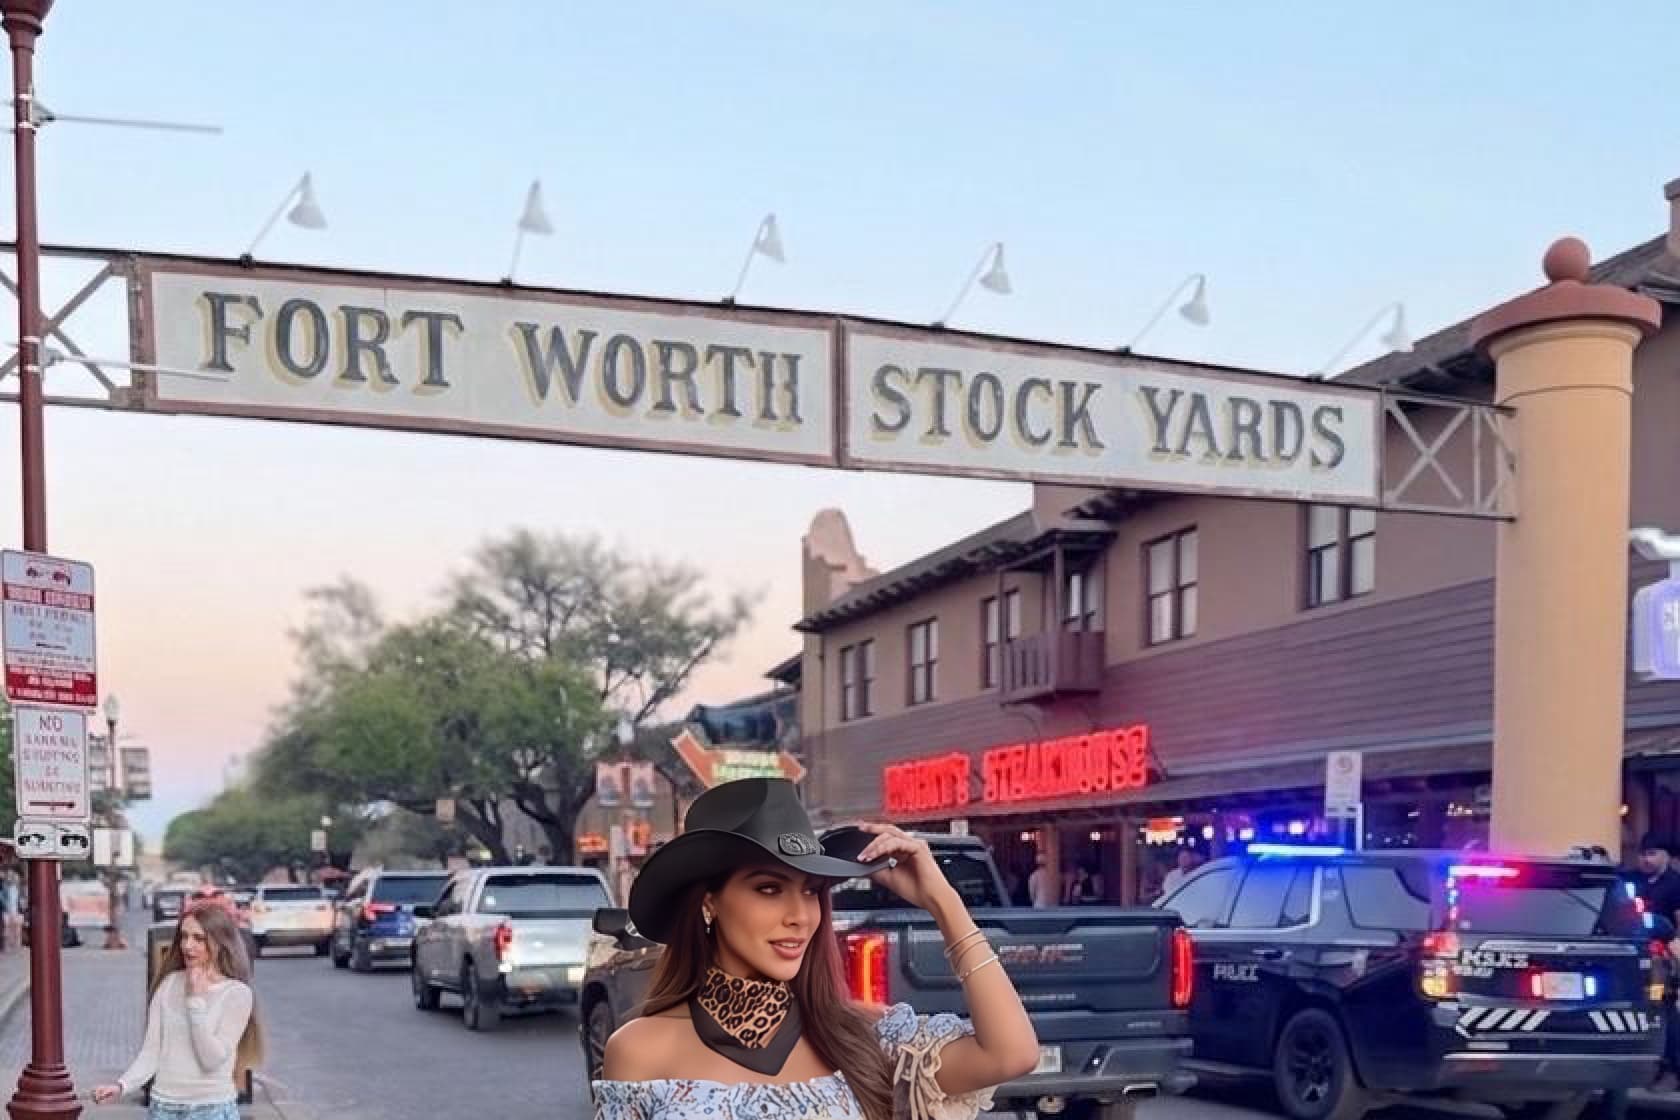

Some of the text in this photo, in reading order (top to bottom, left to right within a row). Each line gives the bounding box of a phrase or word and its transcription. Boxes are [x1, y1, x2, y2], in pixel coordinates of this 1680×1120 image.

[199, 290, 1347, 470] FORT WORTH STOCK YARDS
[39, 714, 63, 732] NO
